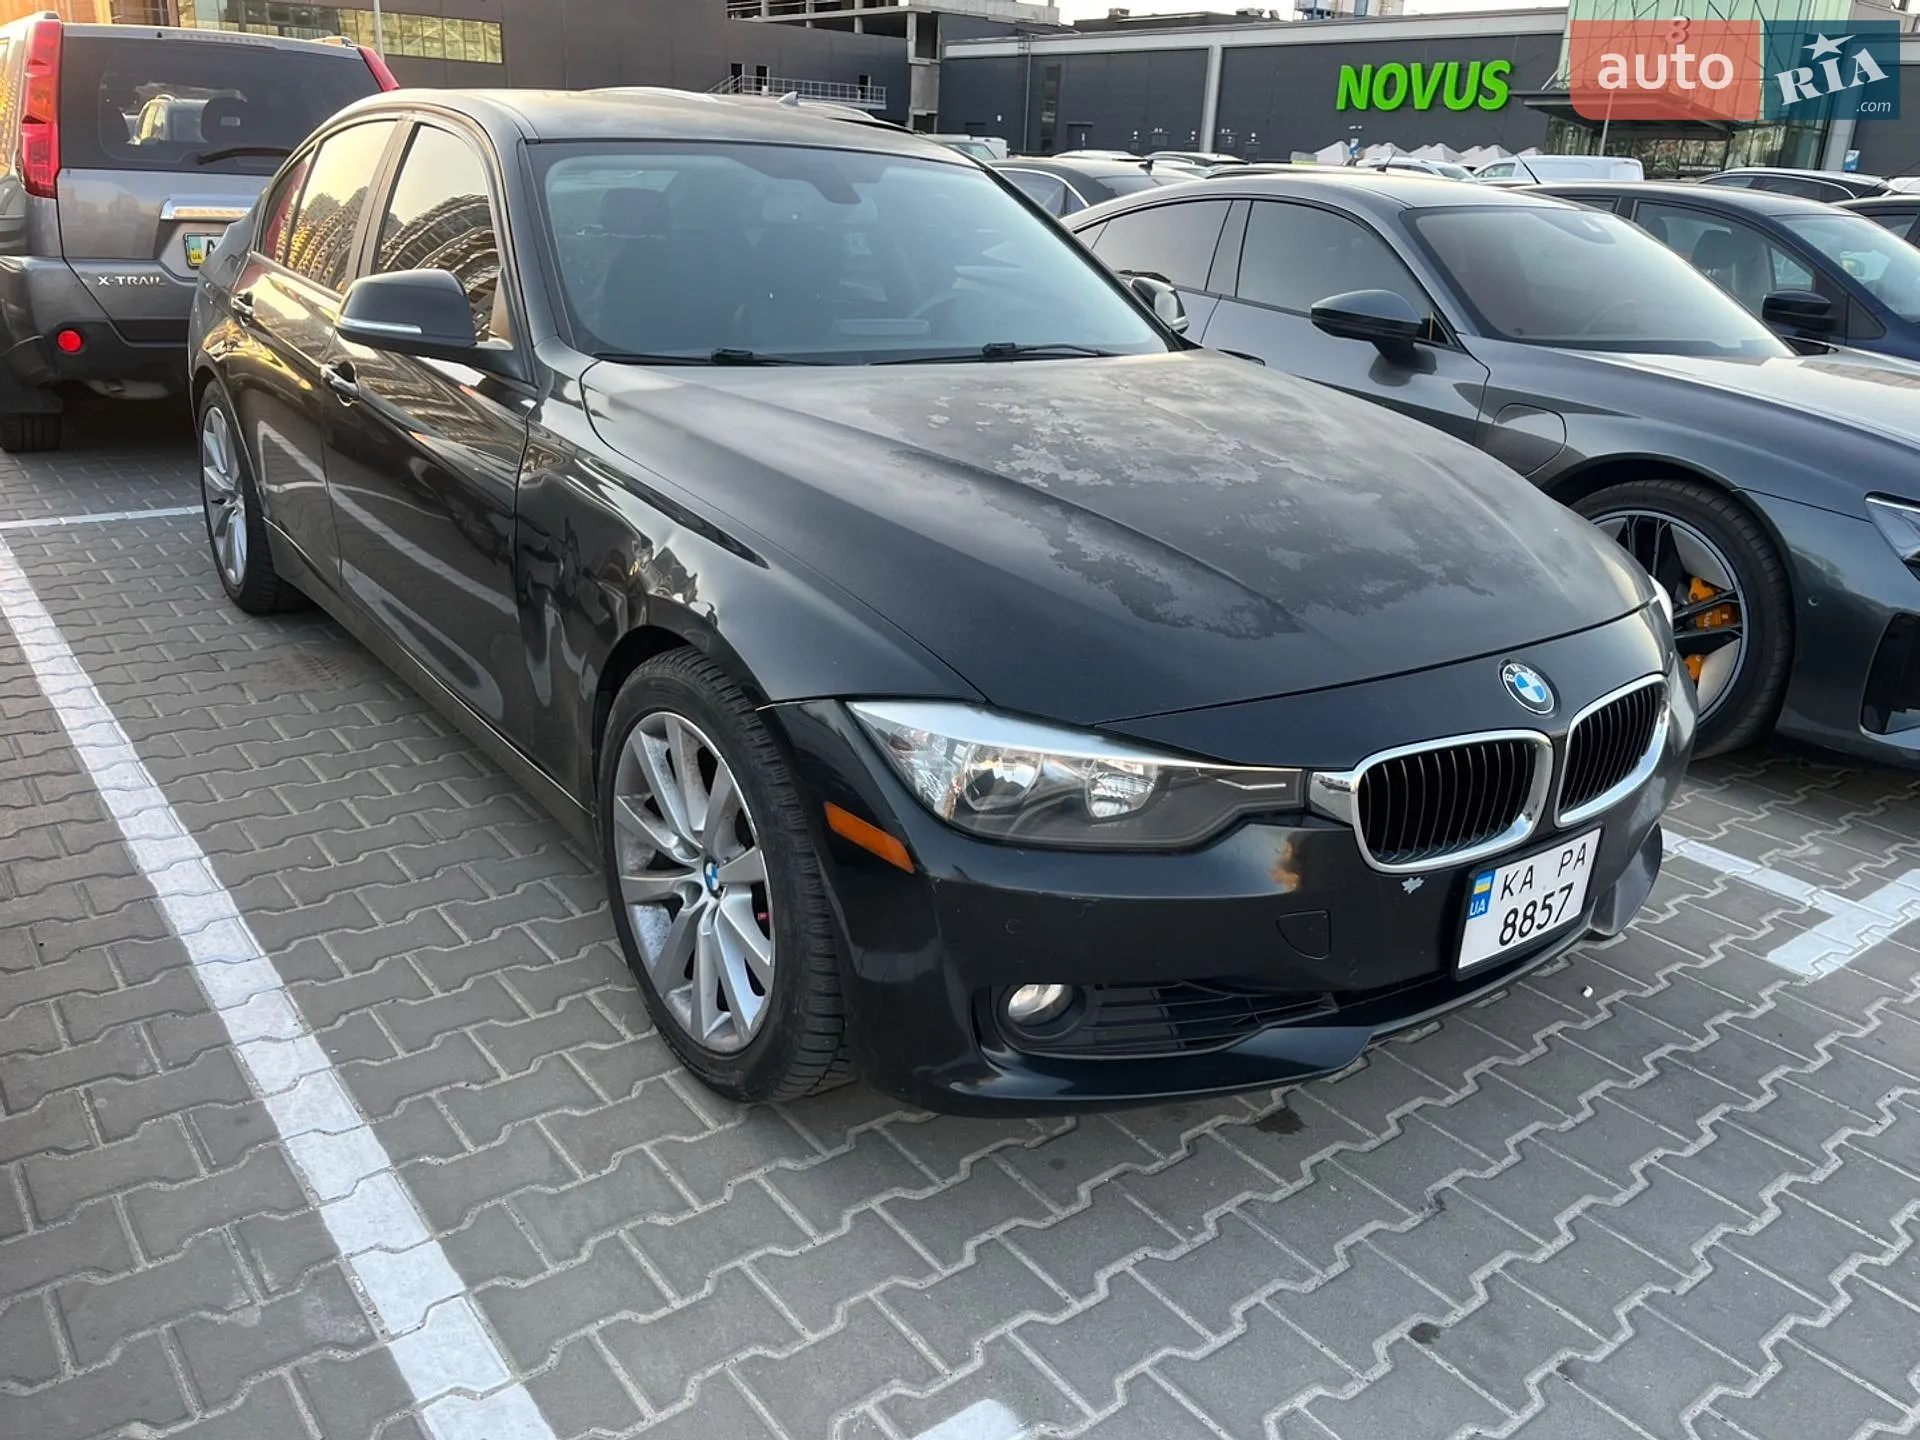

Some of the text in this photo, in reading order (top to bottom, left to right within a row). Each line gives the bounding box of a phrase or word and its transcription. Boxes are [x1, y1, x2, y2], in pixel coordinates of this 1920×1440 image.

[1336, 59, 1512, 112] NOVUS
[98, 276, 166, 286] X-TRAIL
[1500, 842, 1587, 901] KA PA
[1469, 898, 1486, 916] UA
[1499, 881, 1575, 947] 8857
